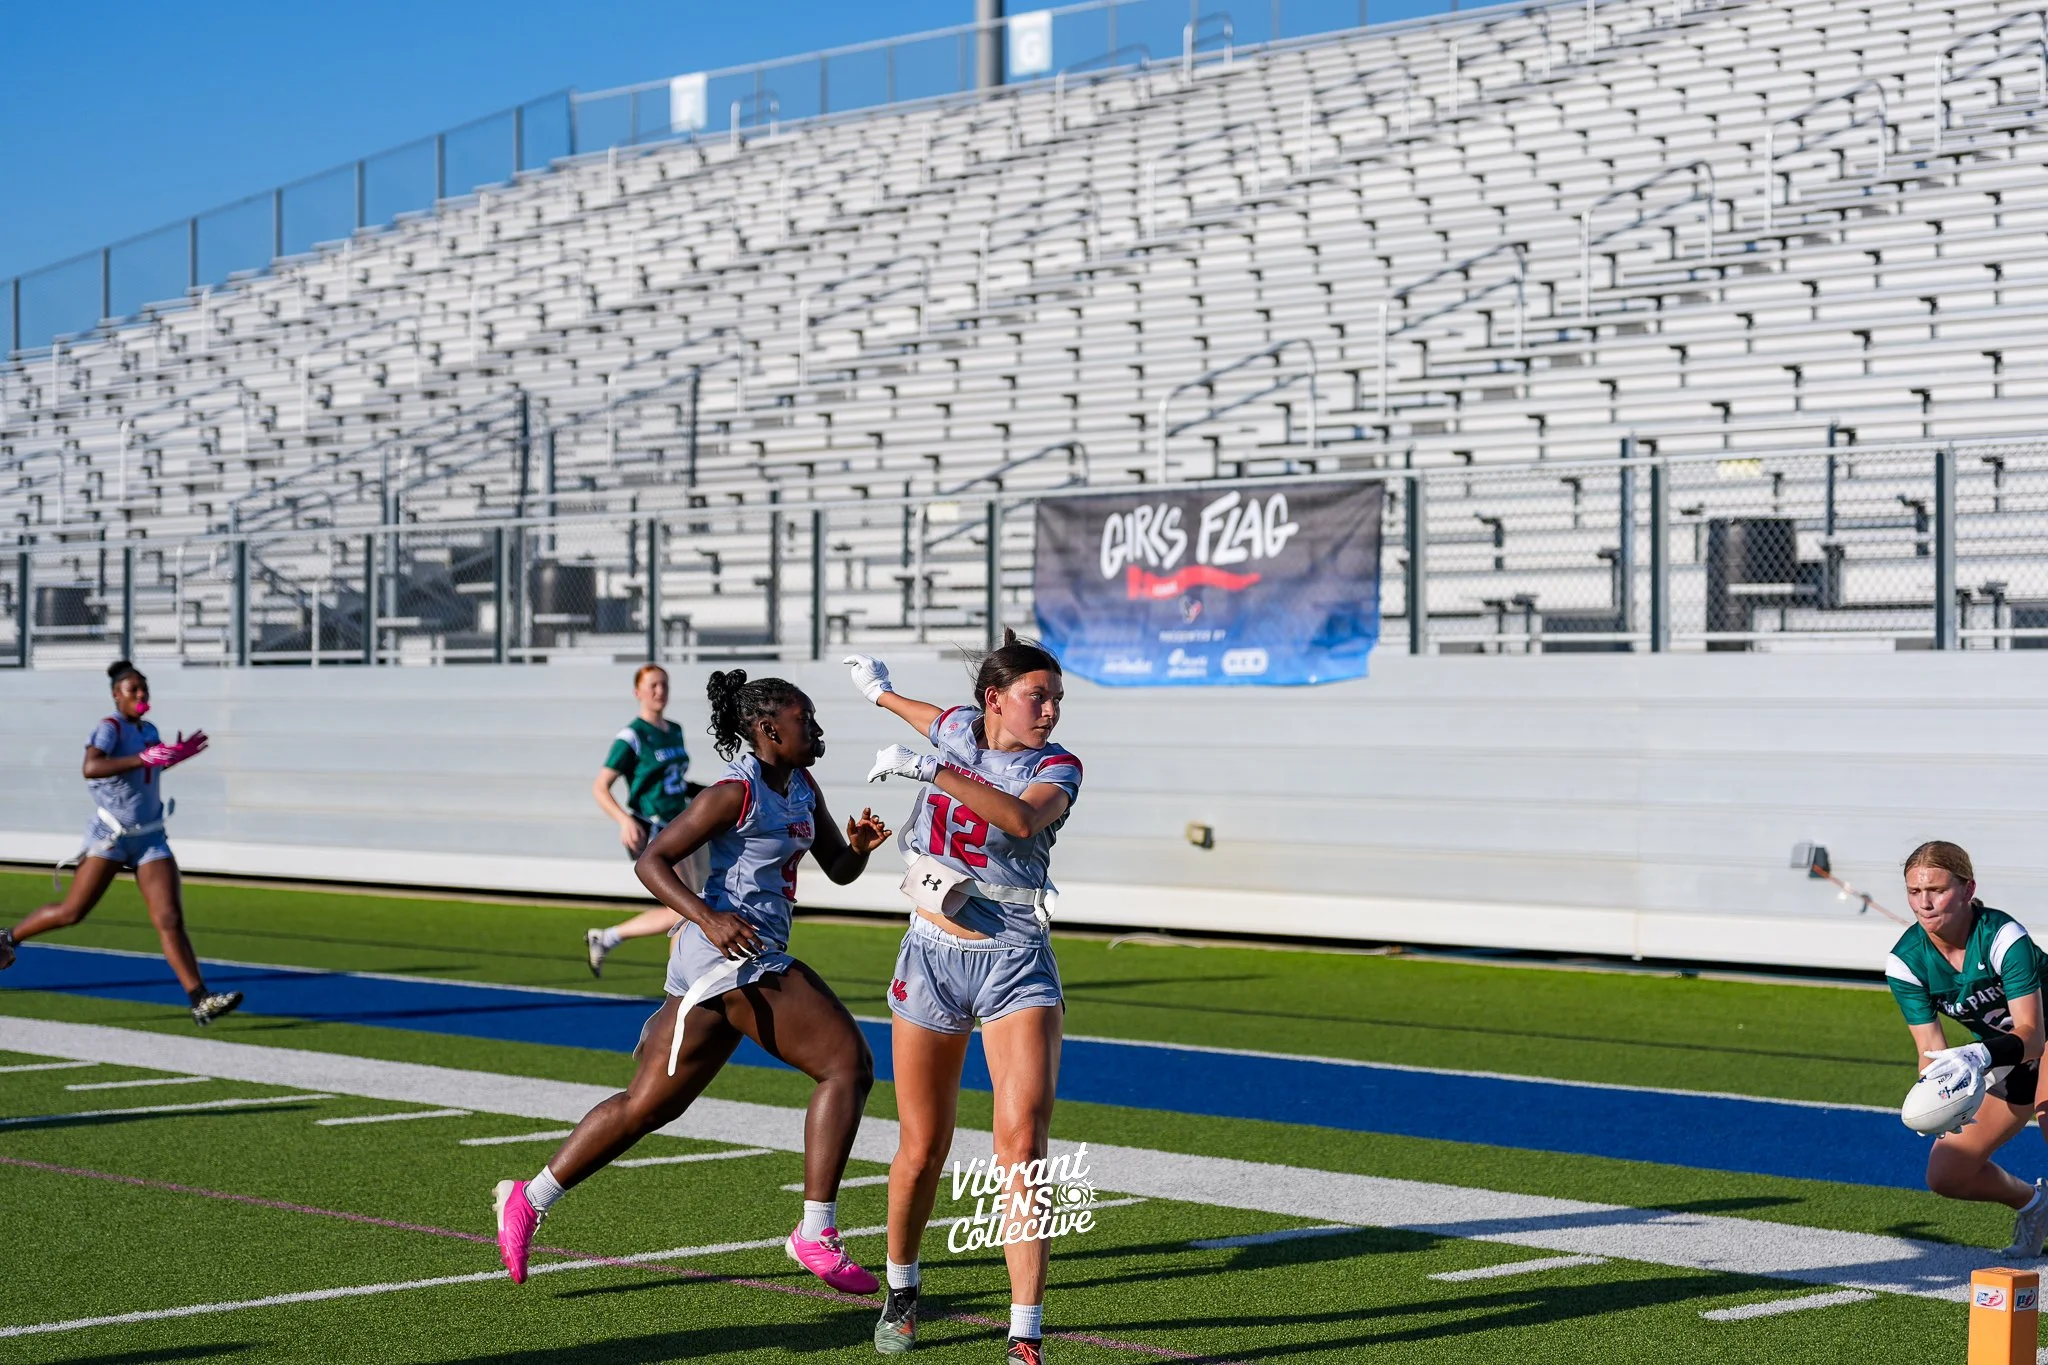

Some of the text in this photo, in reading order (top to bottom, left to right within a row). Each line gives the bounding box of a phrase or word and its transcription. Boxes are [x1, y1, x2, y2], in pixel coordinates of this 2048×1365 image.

[1019, 32, 1043, 65] G
[1100, 490, 1299, 580] GIRLS FLAG
[927, 794, 989, 868] 12
